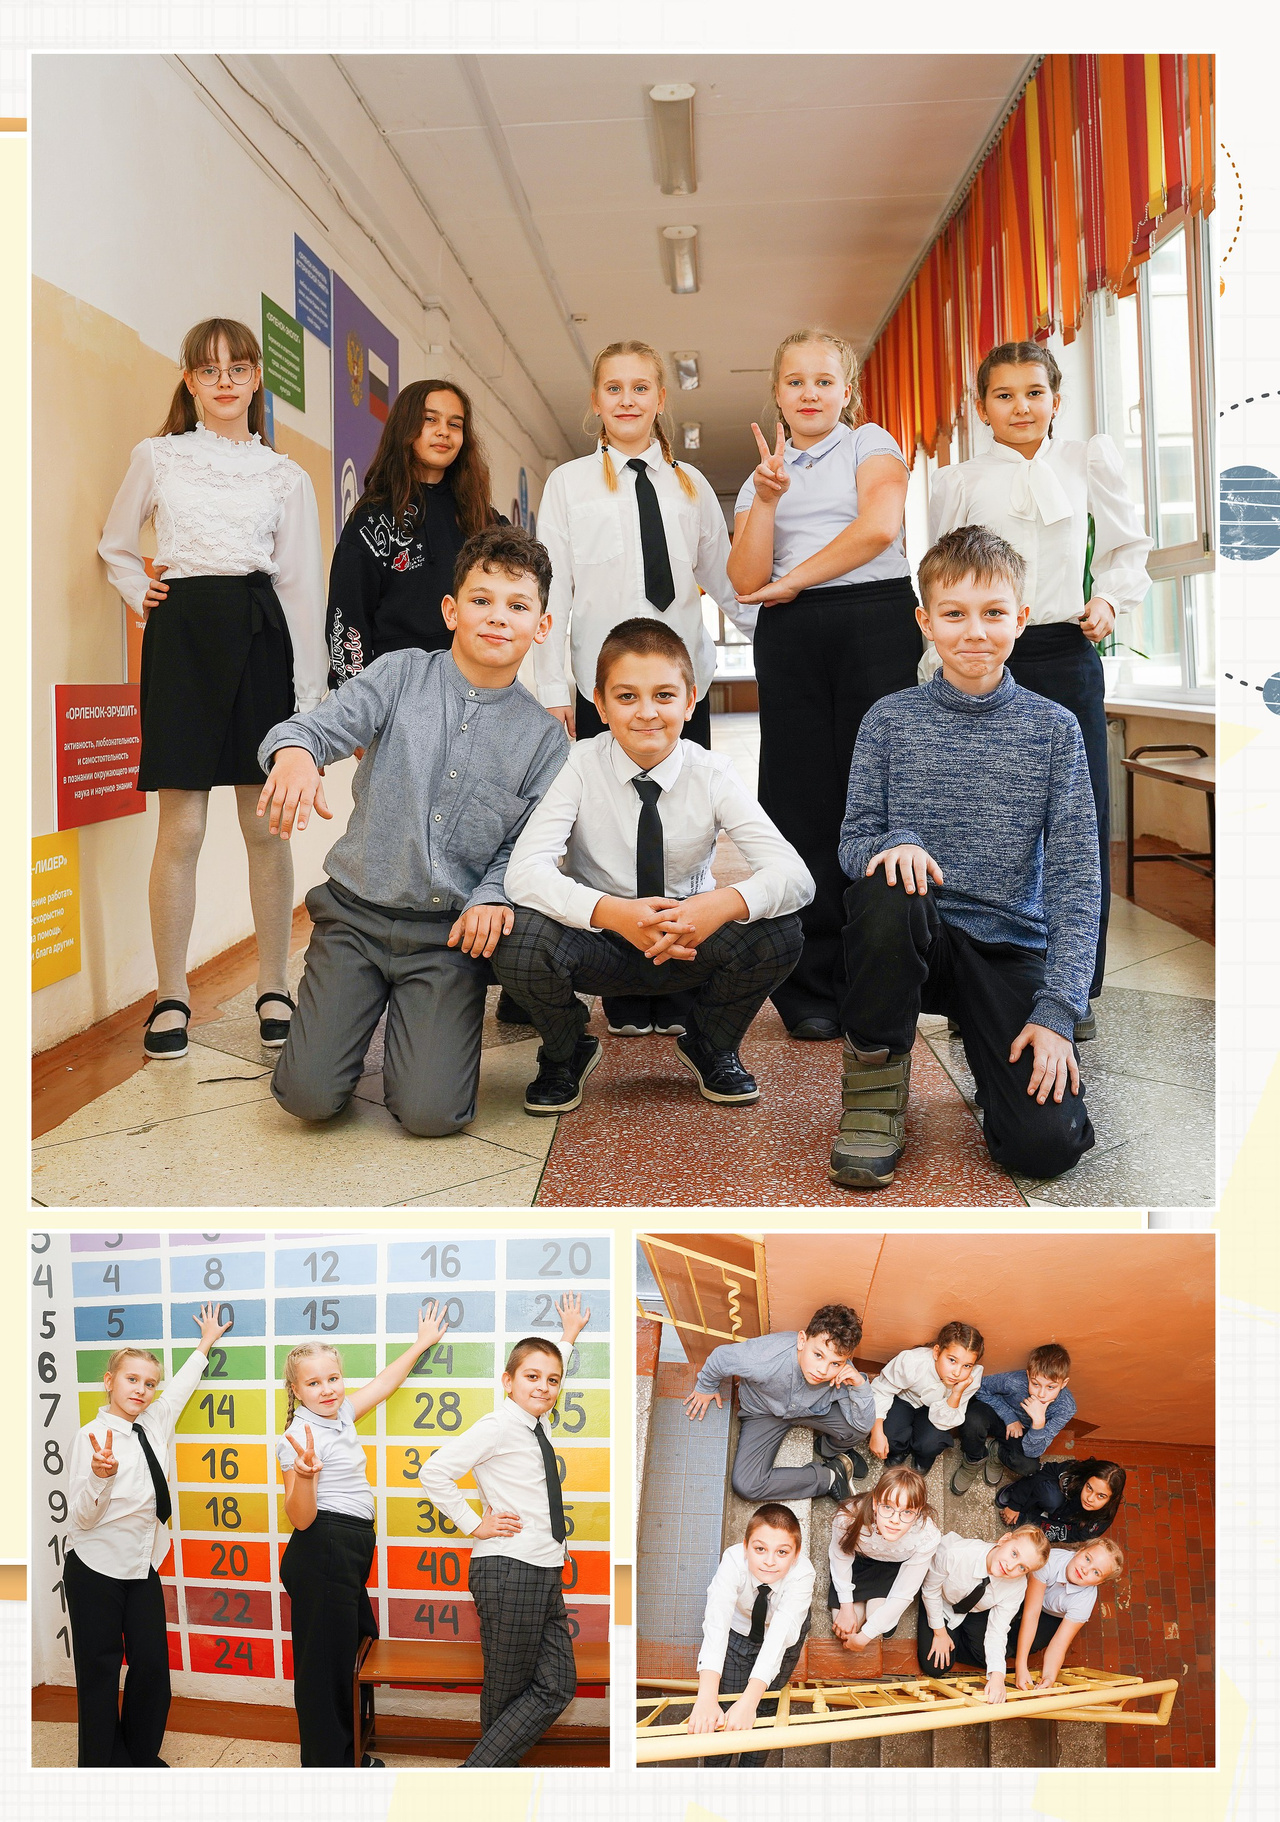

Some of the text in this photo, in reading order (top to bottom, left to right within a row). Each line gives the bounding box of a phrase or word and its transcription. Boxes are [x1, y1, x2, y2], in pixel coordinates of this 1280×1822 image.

[343, 626, 363, 676] babe
[65, 705, 138, 720] «ОРЛЕНОК-ЭРУДИТ»
[64, 736, 140, 751] активность, любознательность
[77, 752, 129, 766] и самостоятельность
[63, 776, 67, 784] в
[68, 772, 93, 784] познании
[94, 767, 128, 780] окружающего
[74, 789, 90, 800] наука
[95, 784, 116, 796] научное
[116, 782, 133, 791] знание
[31, 855, 68, 875] -ЛИДЕР»
[47, 888, 73, 905] работать
[35, 945, 53, 959] блага
[53, 938, 74, 954] другим
[32, 1241, 591, 1299] 4 4 8 12 16 20
[39, 1310, 56, 1339] 5
[107, 1308, 125, 1337] 5
[303, 1299, 340, 1331] 15
[38, 1351, 57, 1383] 6
[40, 1394, 61, 1427] 7
[200, 1394, 235, 1429] 14
[413, 1391, 462, 1432] 28
[43, 1440, 64, 1475] 8
[202, 1448, 240, 1480] 16
[48, 1490, 68, 1523] 9
[206, 1497, 241, 1529] 18
[211, 1543, 248, 1577] 20
[416, 1550, 461, 1586] 40
[212, 1592, 254, 1623] 22
[414, 1604, 459, 1635] 44
[214, 1638, 253, 1670] 24
